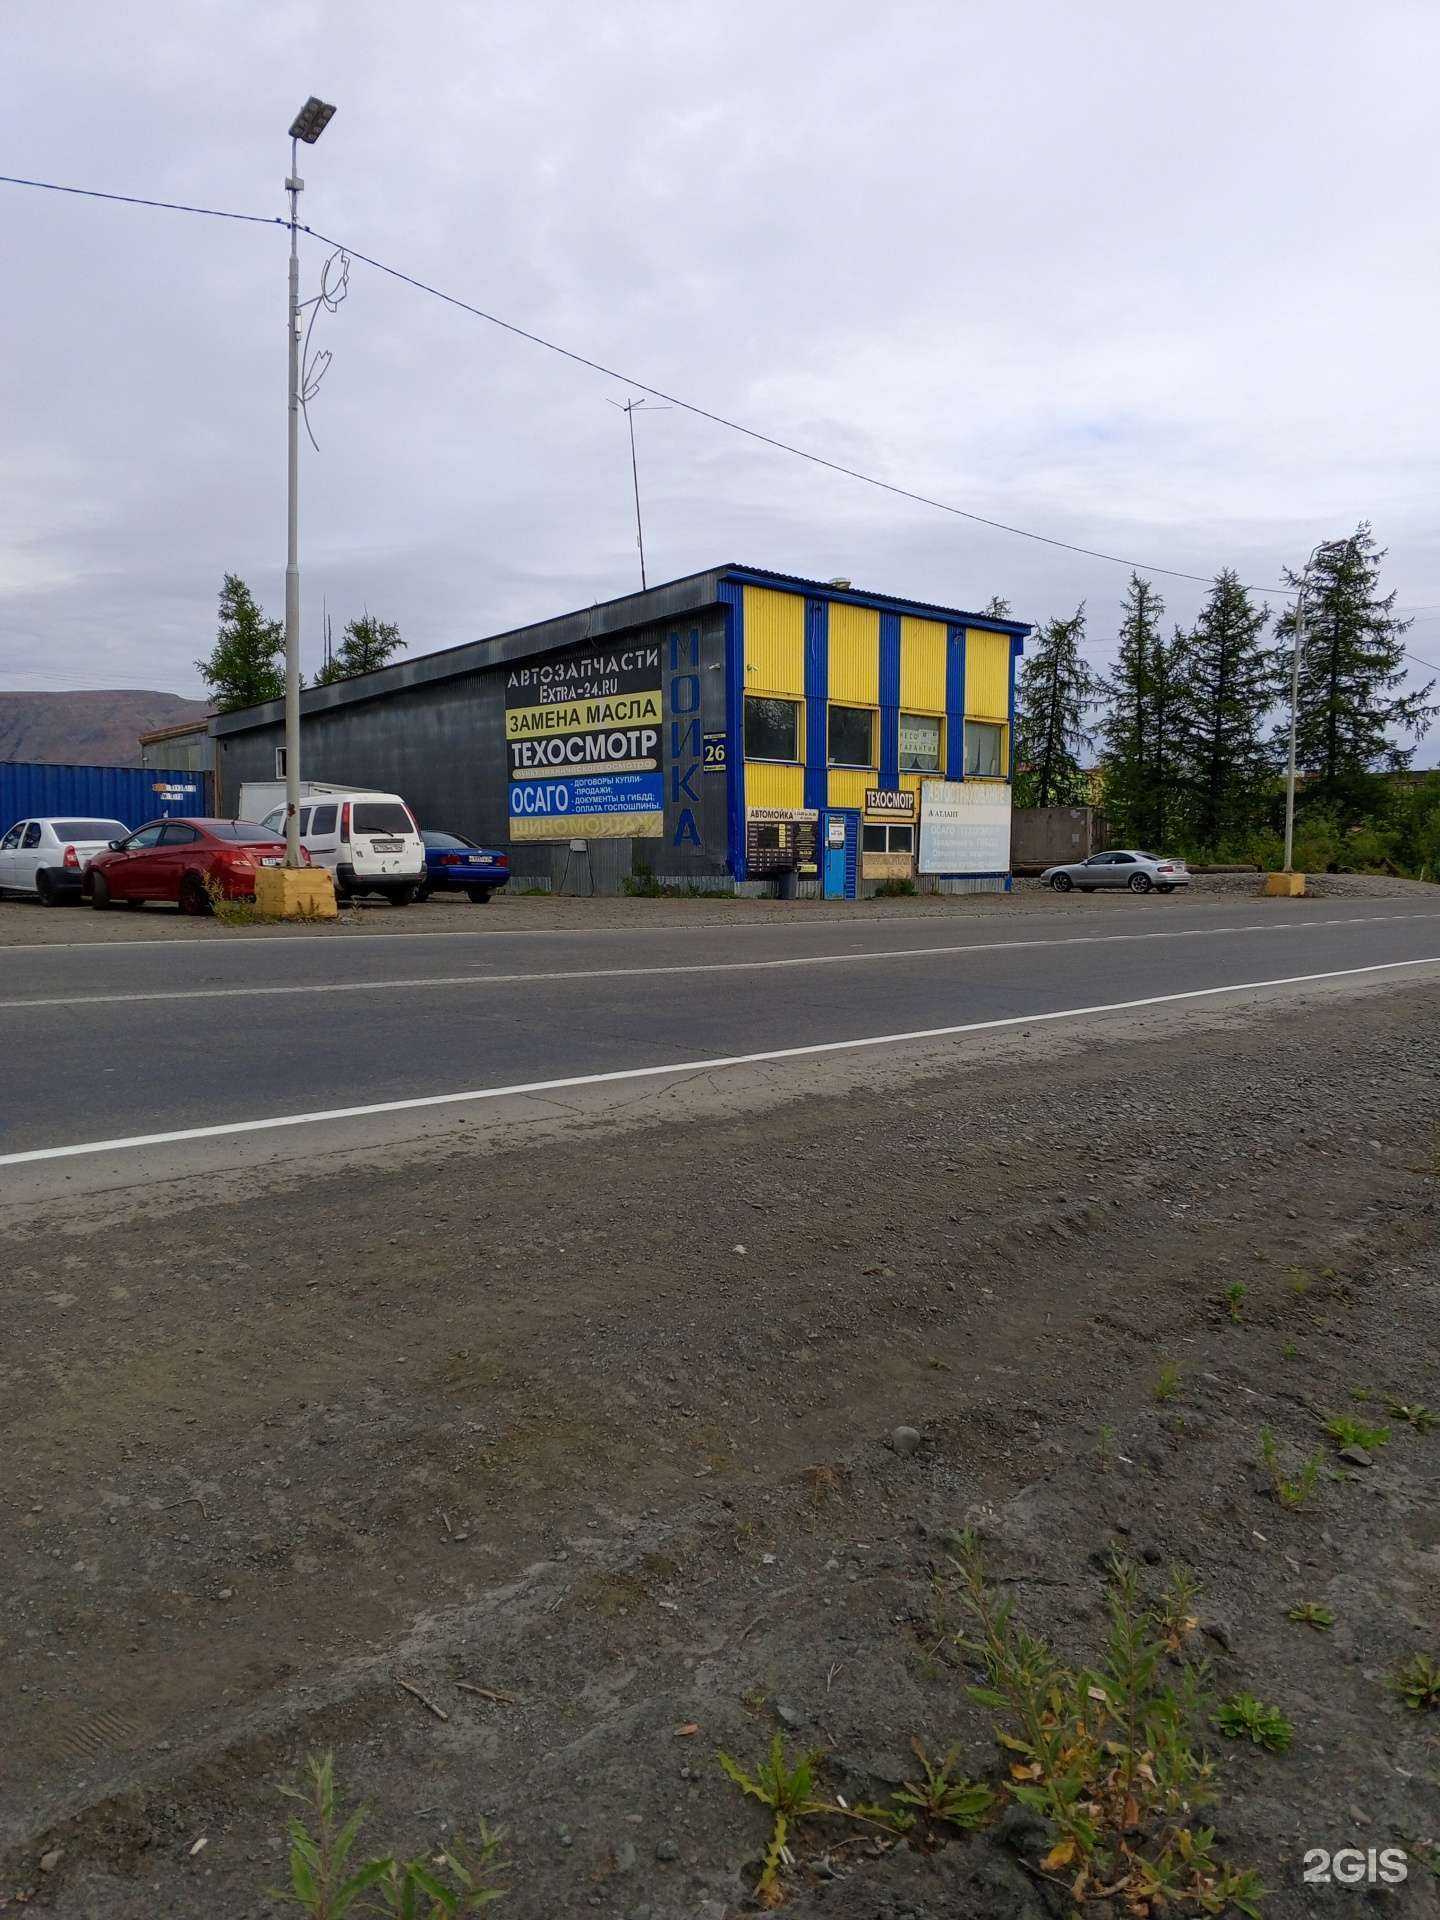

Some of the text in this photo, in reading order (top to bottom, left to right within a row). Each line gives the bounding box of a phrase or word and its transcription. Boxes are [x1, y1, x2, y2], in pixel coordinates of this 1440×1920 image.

[507, 648, 658, 688] АВТОЗАПЧАСТИ
[510, 698, 657, 733] ЗАМЕНА МАСЛА
[511, 729, 658, 767] ТЕХОСМОТР
[704, 744, 725, 762] 26
[511, 784, 569, 813] ОСАГО
[575, 795, 619, 805] ДОКУМЕНТЫ
[866, 791, 914, 809] ТЕХОСМОТР
[575, 804, 602, 813] ОПЛАТА
[750, 808, 794, 820] АВТОМОЙКА
